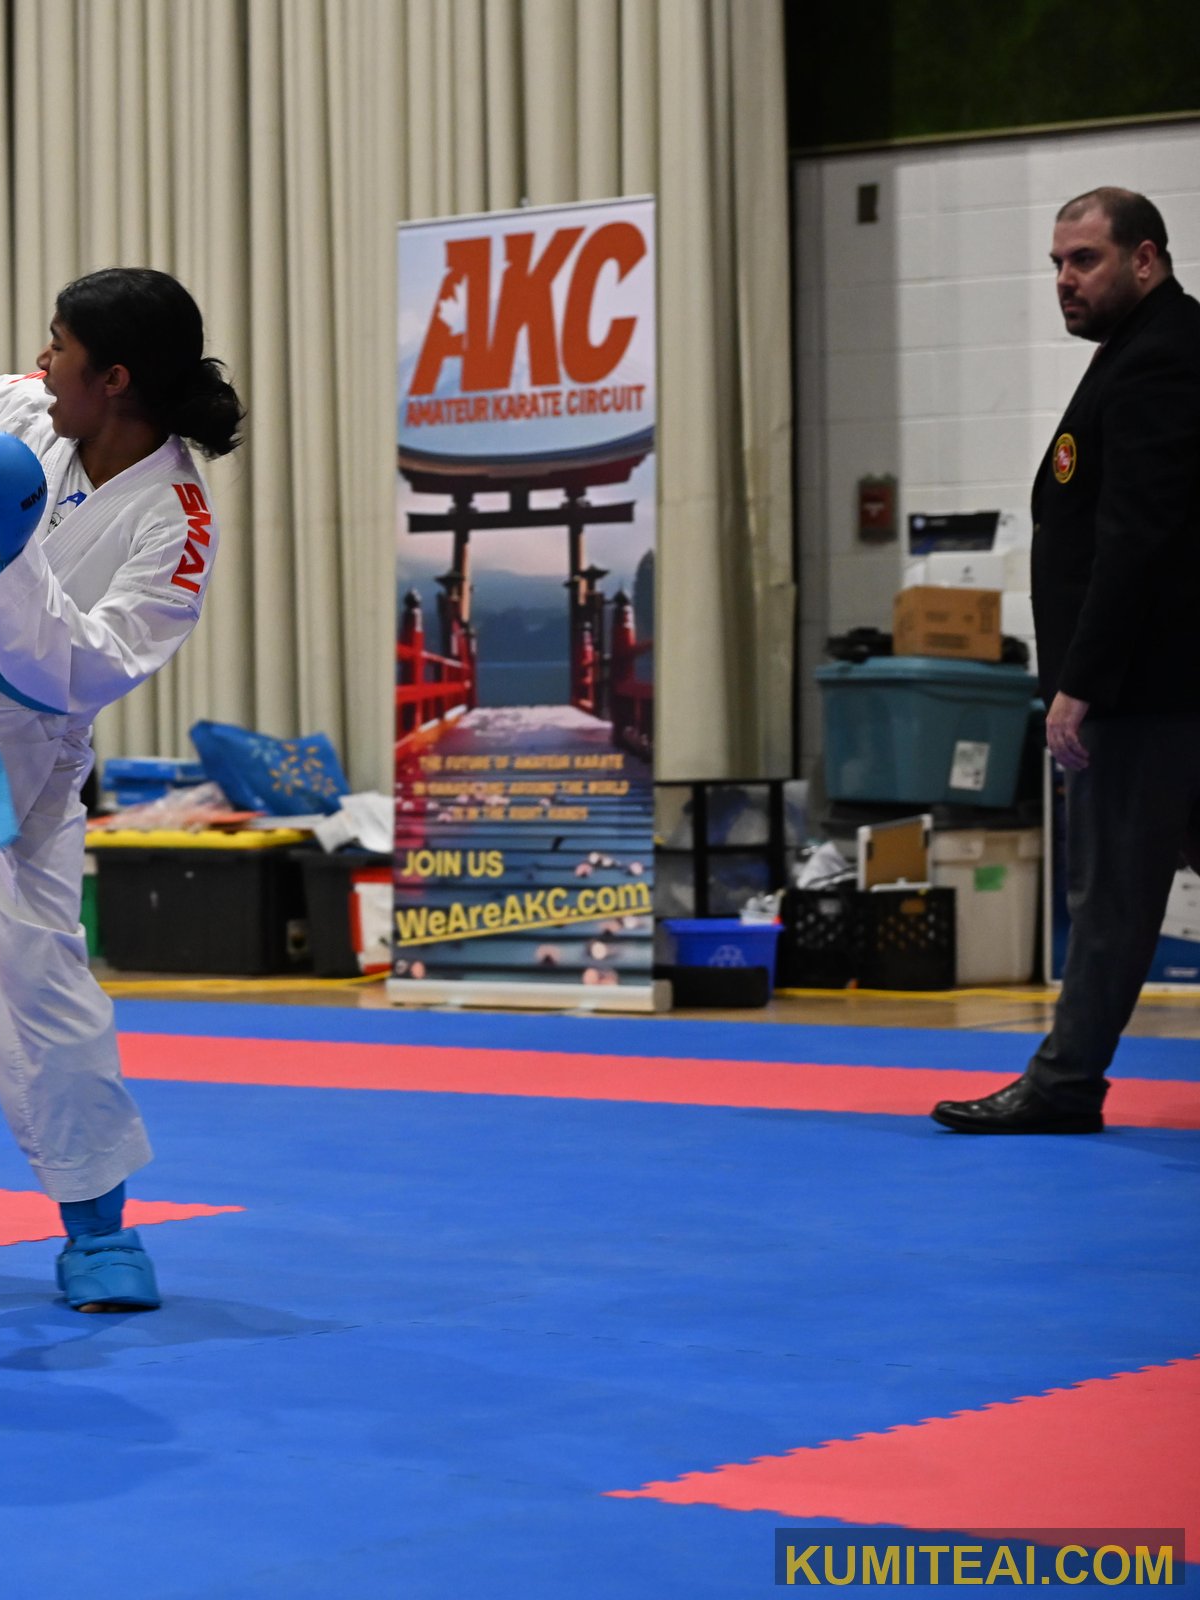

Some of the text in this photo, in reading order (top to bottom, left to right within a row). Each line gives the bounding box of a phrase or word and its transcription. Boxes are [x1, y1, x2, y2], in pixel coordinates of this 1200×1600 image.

[408, 220, 648, 397] AKC
[405, 385, 646, 428] AMATEUR KARATE CIRCUIT
[171, 483, 212, 594] SMAI
[402, 851, 504, 878] JOIN US
[396, 882, 651, 942] WeAreAKC.com
